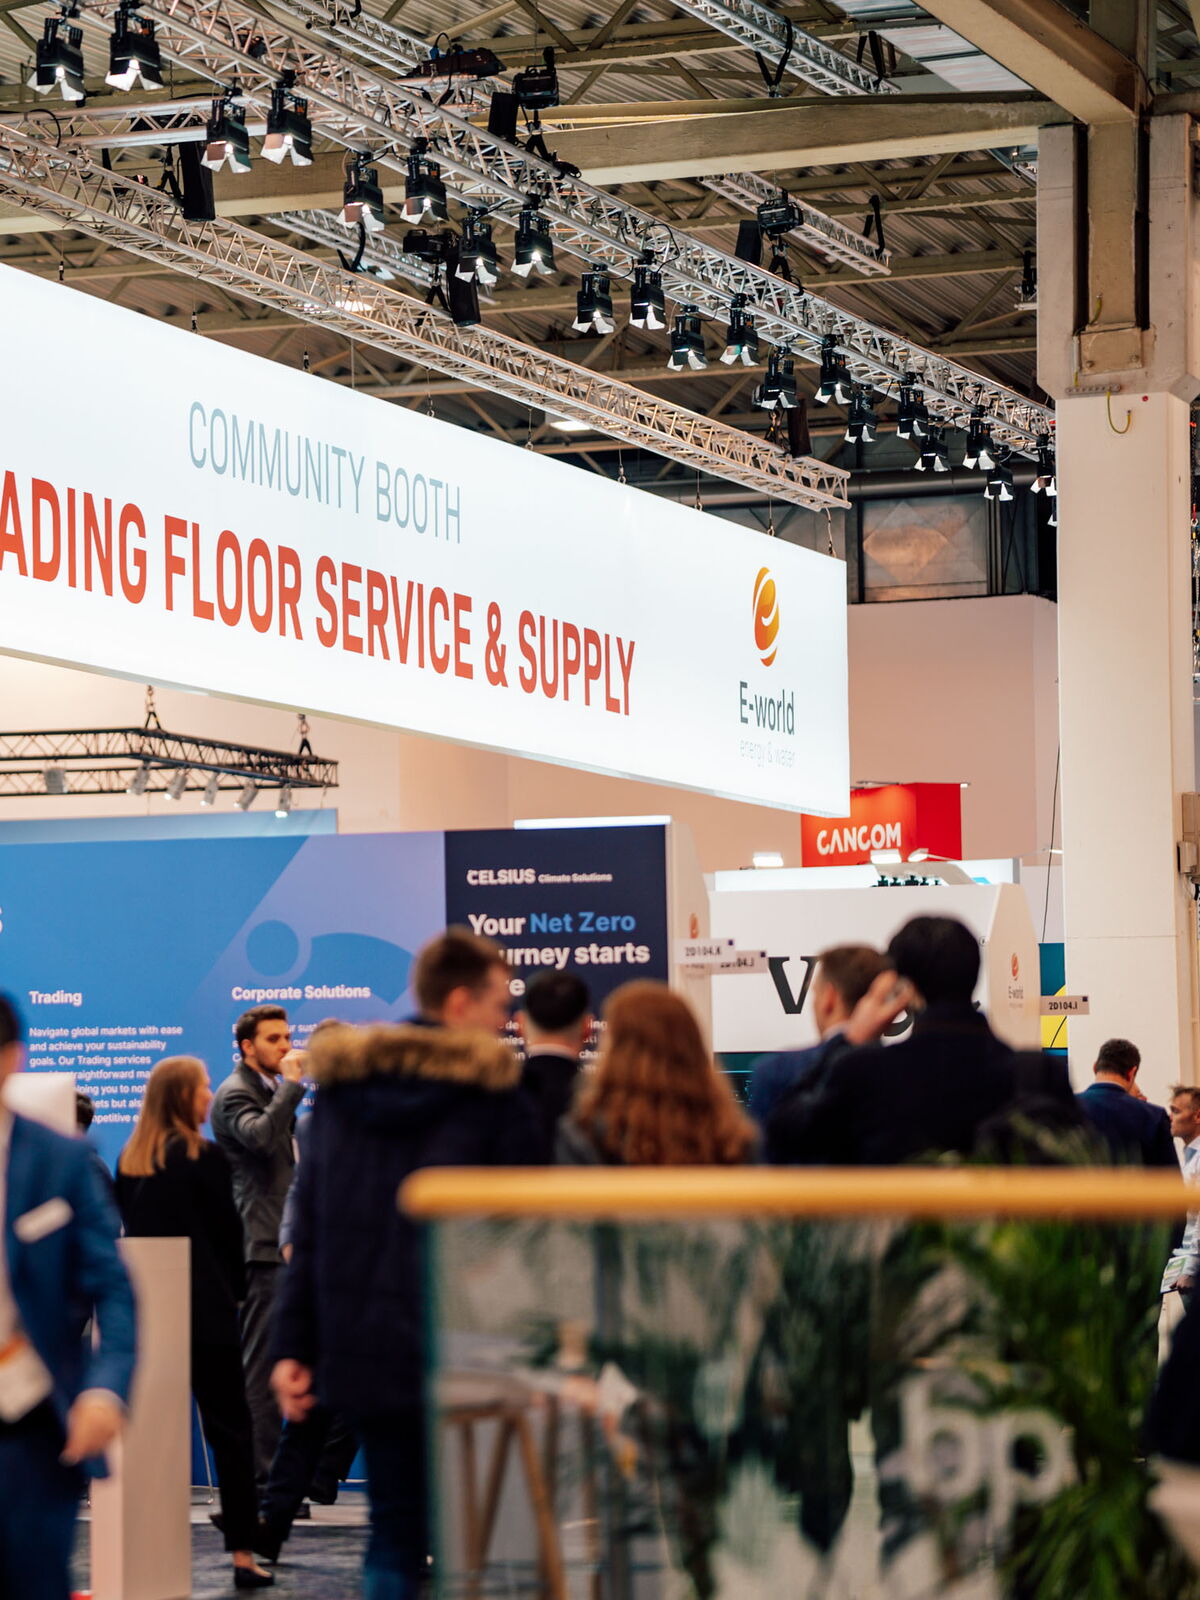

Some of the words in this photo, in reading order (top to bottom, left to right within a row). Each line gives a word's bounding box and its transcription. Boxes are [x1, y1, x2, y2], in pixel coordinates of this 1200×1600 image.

[189, 401, 365, 514] COMMUNITY
[376, 460, 461, 544] BOOTH
[164, 514, 303, 640] FLOOR
[315, 555, 473, 680] SERVICE
[485, 601, 508, 688] &
[519, 610, 635, 716] SUPPLY
[739, 680, 795, 735] E-world
[816, 822, 901, 855] CANCOM
[467, 868, 536, 885] CELSIUS
[538, 873, 571, 884] Climate
[571, 872, 613, 883] Solutions
[468, 914, 526, 936] Your
[530, 912, 573, 933] Net
[578, 911, 636, 932] Zero
[574, 942, 650, 965] starts
[29, 990, 82, 1006] Trading
[232, 986, 302, 1002] Corporate
[304, 984, 371, 998] Solutions
[29, 1027, 69, 1038] Navigate
[71, 1027, 98, 1038] global
[100, 1026, 137, 1036] markets
[139, 1025, 158, 1035] with
[160, 1026, 183, 1035] ease
[29, 1042, 46, 1051] and
[48, 1041, 83, 1051] achieve
[85, 1042, 105, 1052] your
[108, 1040, 166, 1051] sustainability
[29, 1056, 55, 1067] goals.
[58, 1056, 75, 1065] Our
[77, 1055, 111, 1067] Trading
[113, 1056, 151, 1065] services
[101, 1085, 117, 1095] you
[120, 1085, 129, 1093] to
[111, 1099, 126, 1108] but
